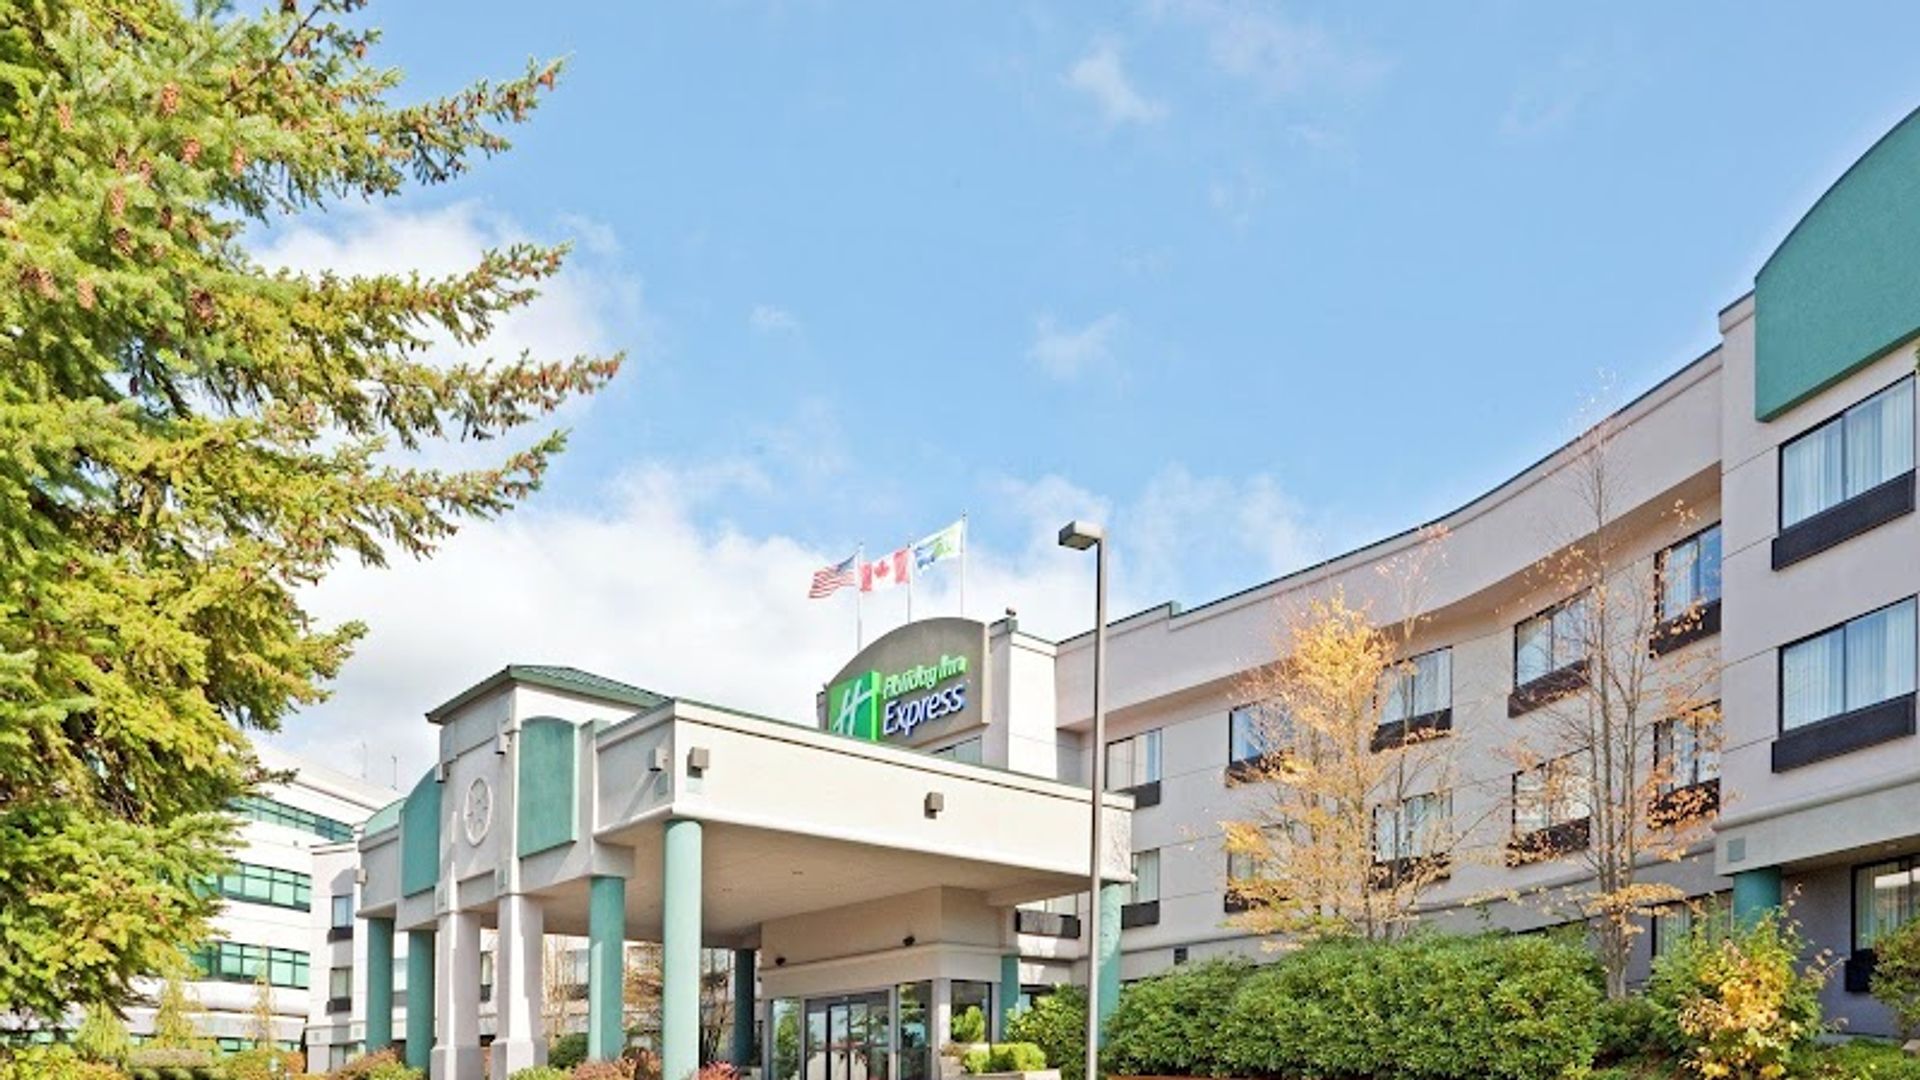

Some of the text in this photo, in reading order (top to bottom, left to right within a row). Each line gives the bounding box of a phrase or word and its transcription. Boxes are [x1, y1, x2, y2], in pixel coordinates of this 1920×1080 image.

[883, 654, 967, 699] Holiday Inn
[883, 684, 965, 736] Express
